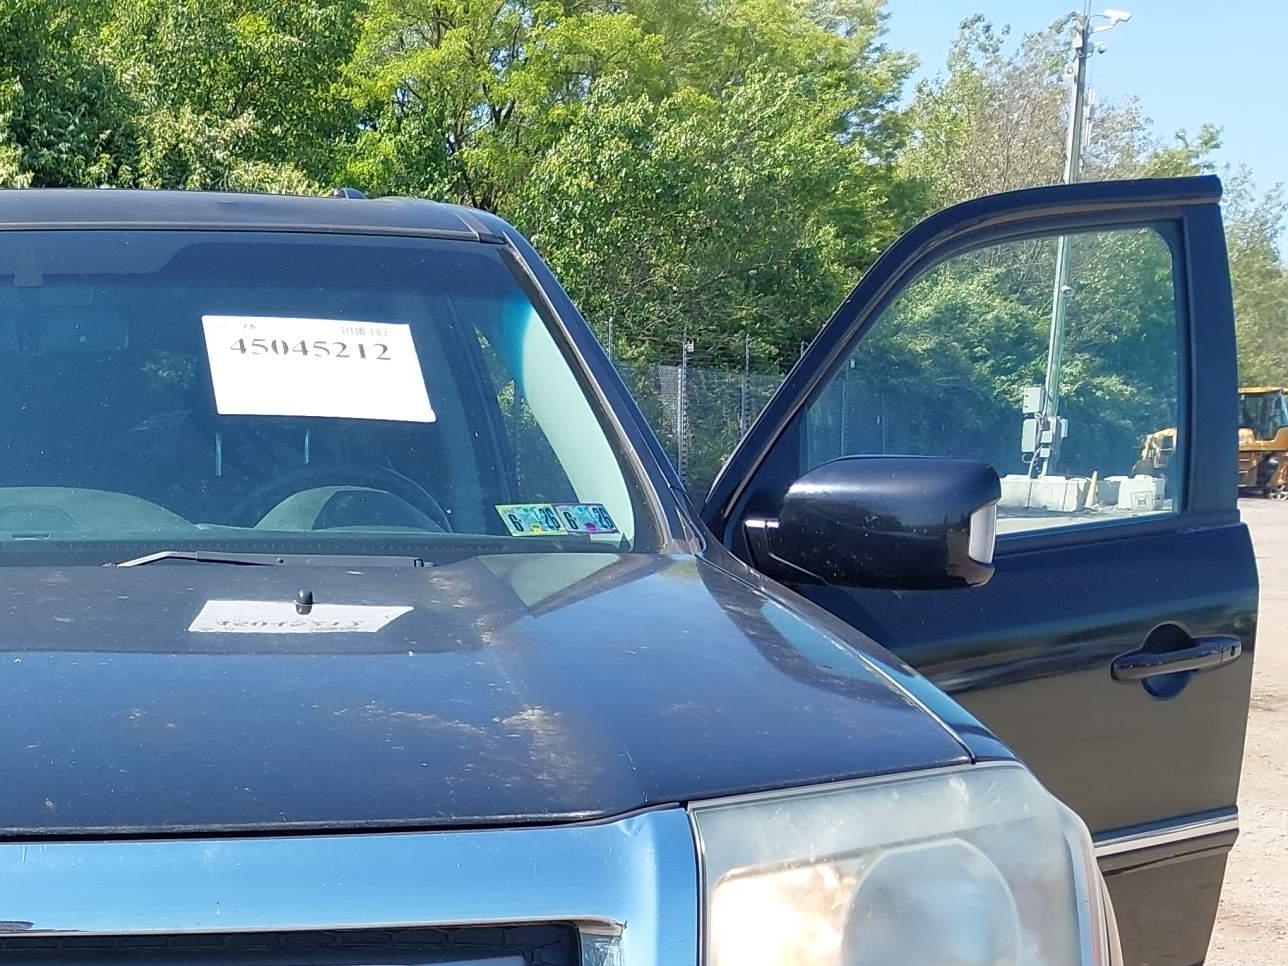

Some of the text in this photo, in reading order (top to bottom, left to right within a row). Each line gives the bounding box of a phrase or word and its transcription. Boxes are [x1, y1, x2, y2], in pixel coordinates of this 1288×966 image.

[229, 337, 392, 360] 45045212
[507, 507, 561, 532] 6 26
[563, 507, 614, 530] 6 26
